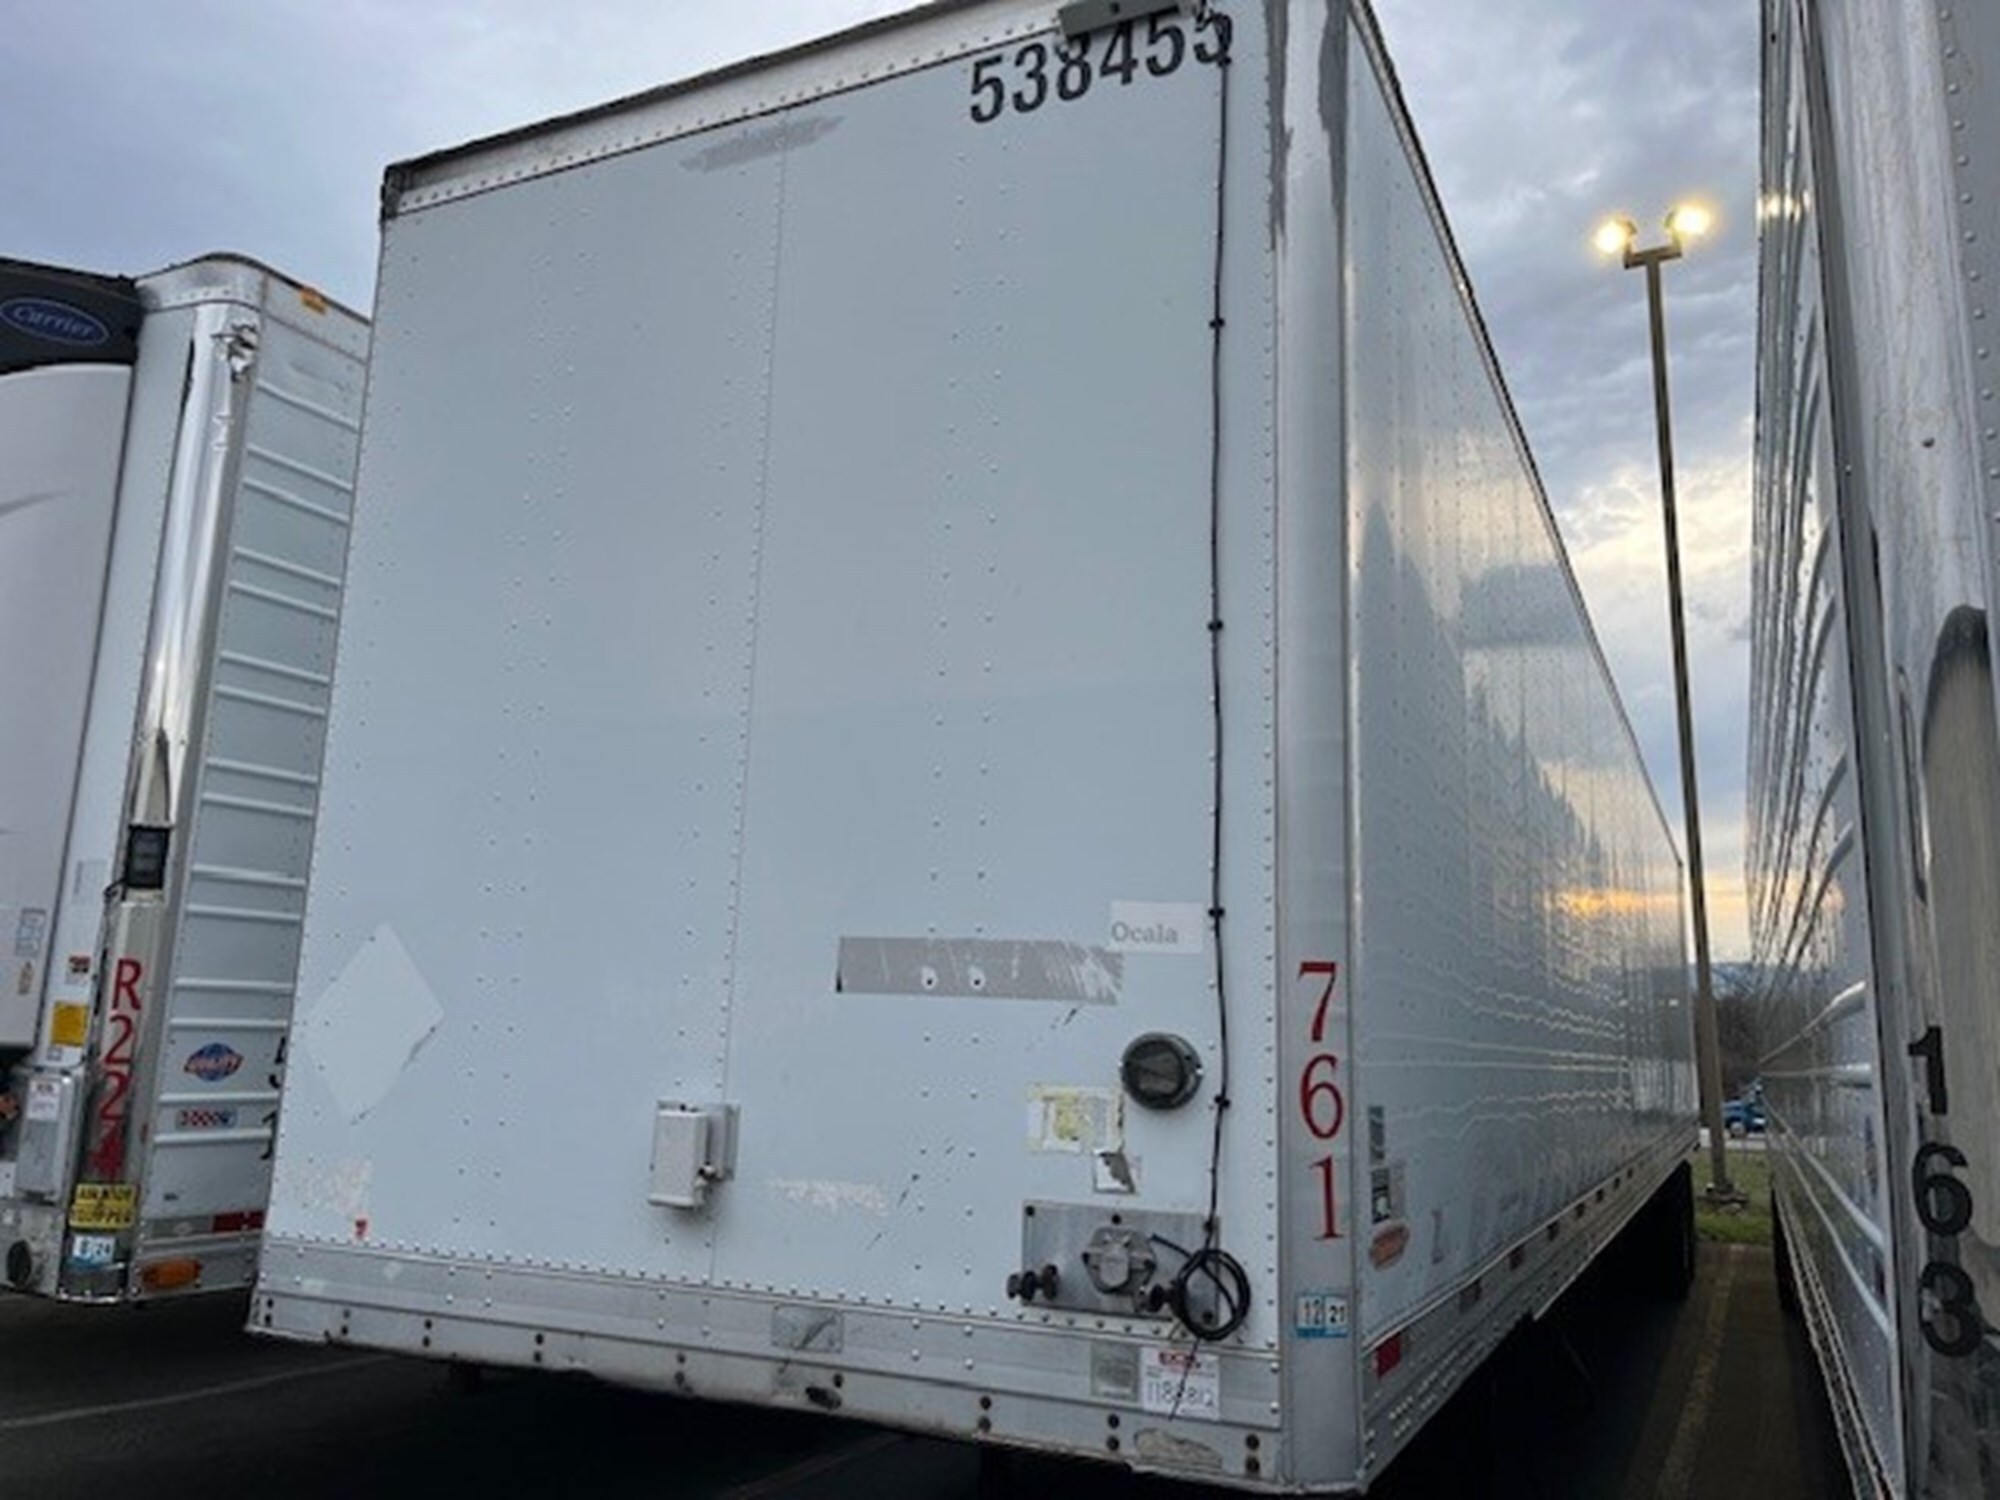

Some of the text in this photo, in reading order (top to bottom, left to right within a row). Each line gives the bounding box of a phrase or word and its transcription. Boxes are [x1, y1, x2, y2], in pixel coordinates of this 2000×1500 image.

[969, 6, 1233, 124] 538455
[14, 306, 94, 337] Carrier
[1111, 921, 1179, 945] Ocala
[1297, 961, 1345, 1241] 761
[1304, 1299, 1346, 1326] 12 21
